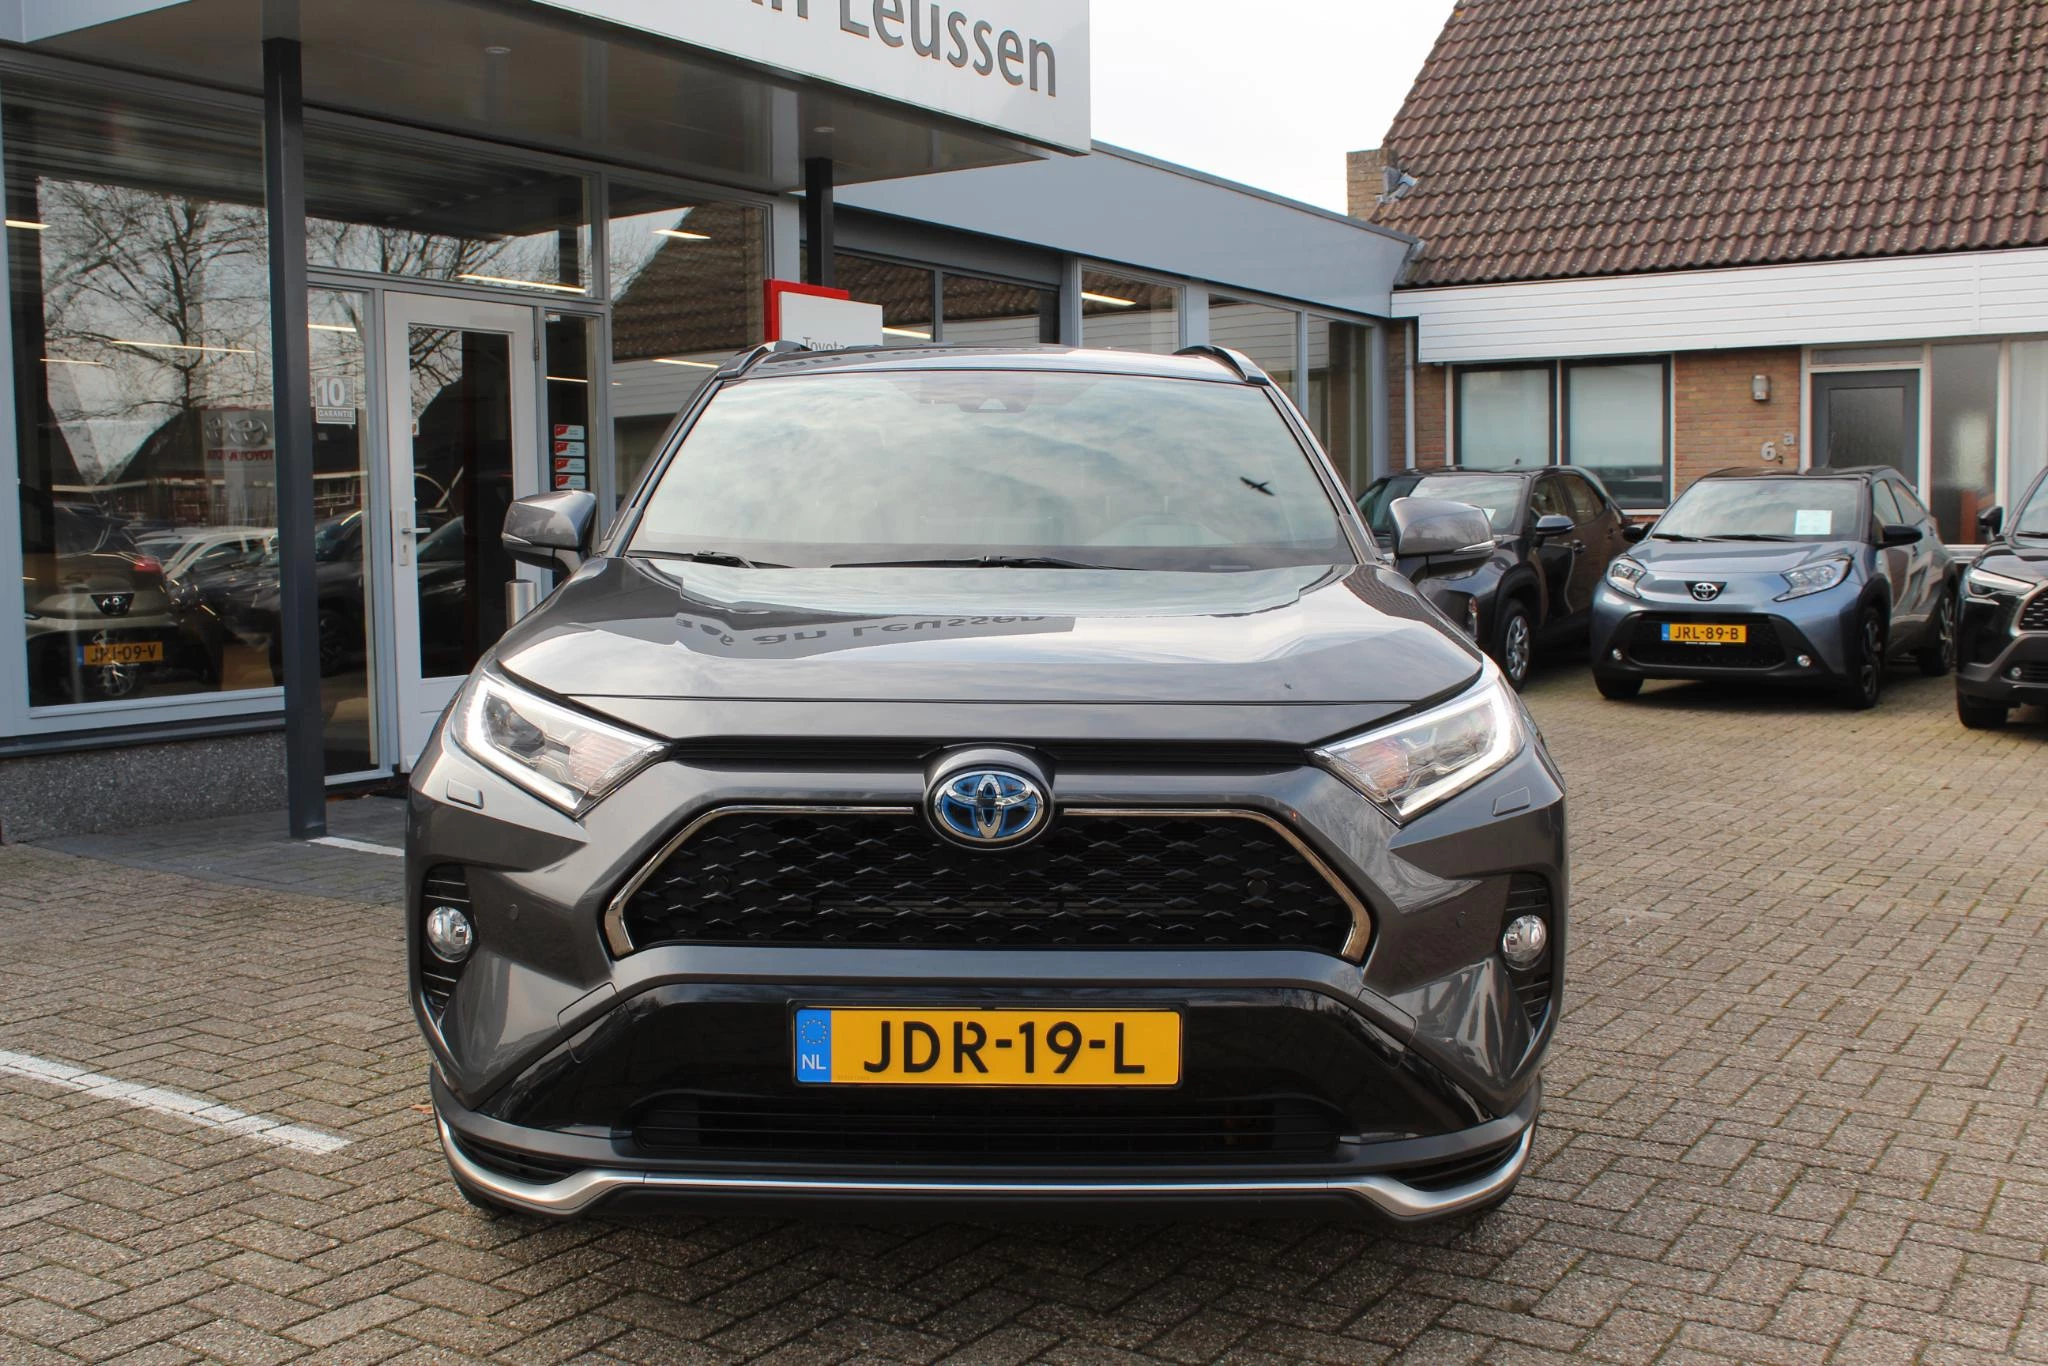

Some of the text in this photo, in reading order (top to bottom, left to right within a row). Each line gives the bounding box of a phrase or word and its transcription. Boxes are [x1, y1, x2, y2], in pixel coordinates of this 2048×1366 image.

[317, 378, 345, 406] 10
[1761, 441, 1776, 460] 6
[1674, 626, 1739, 640] JRL-89-B
[863, 1020, 1146, 1074] JDR-19-L
[801, 1054, 827, 1070] NL
